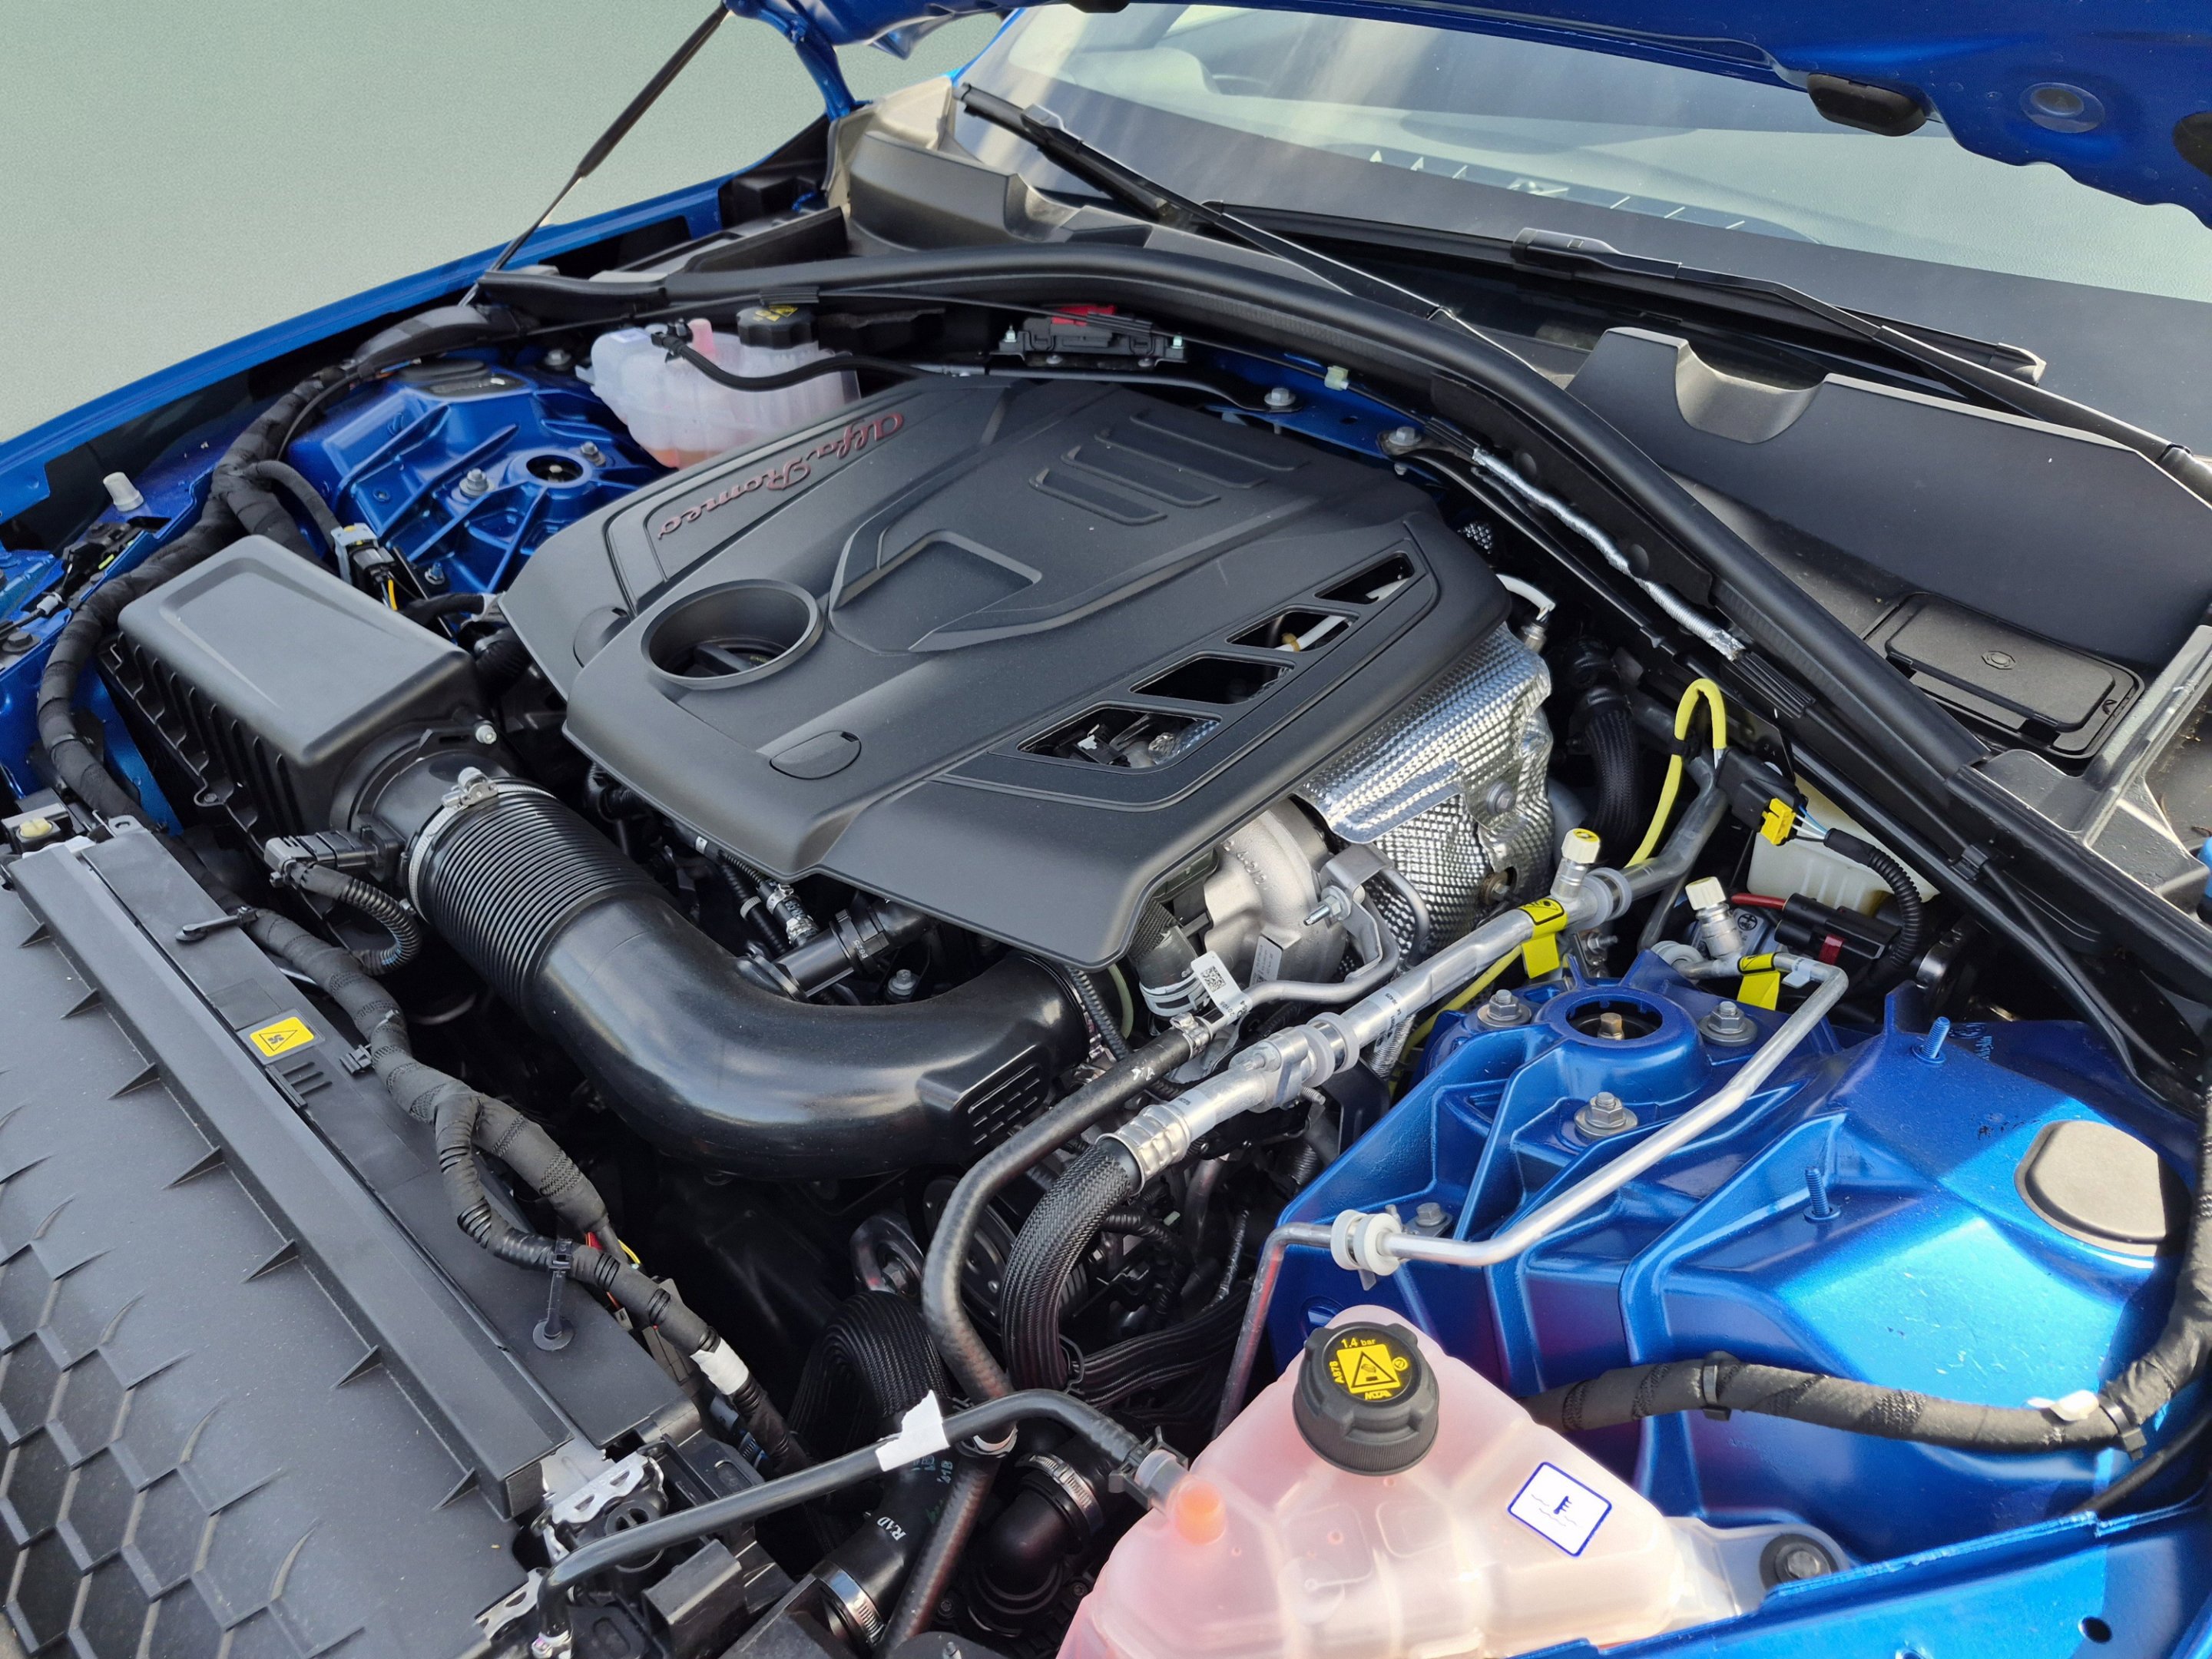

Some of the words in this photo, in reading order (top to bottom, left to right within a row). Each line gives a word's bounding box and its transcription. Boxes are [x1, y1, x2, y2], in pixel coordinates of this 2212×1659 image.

[658, 457, 811, 540] Romeo
[1341, 1337, 1359, 1349] 1.4
[876, 1516, 906, 1541] RAD
